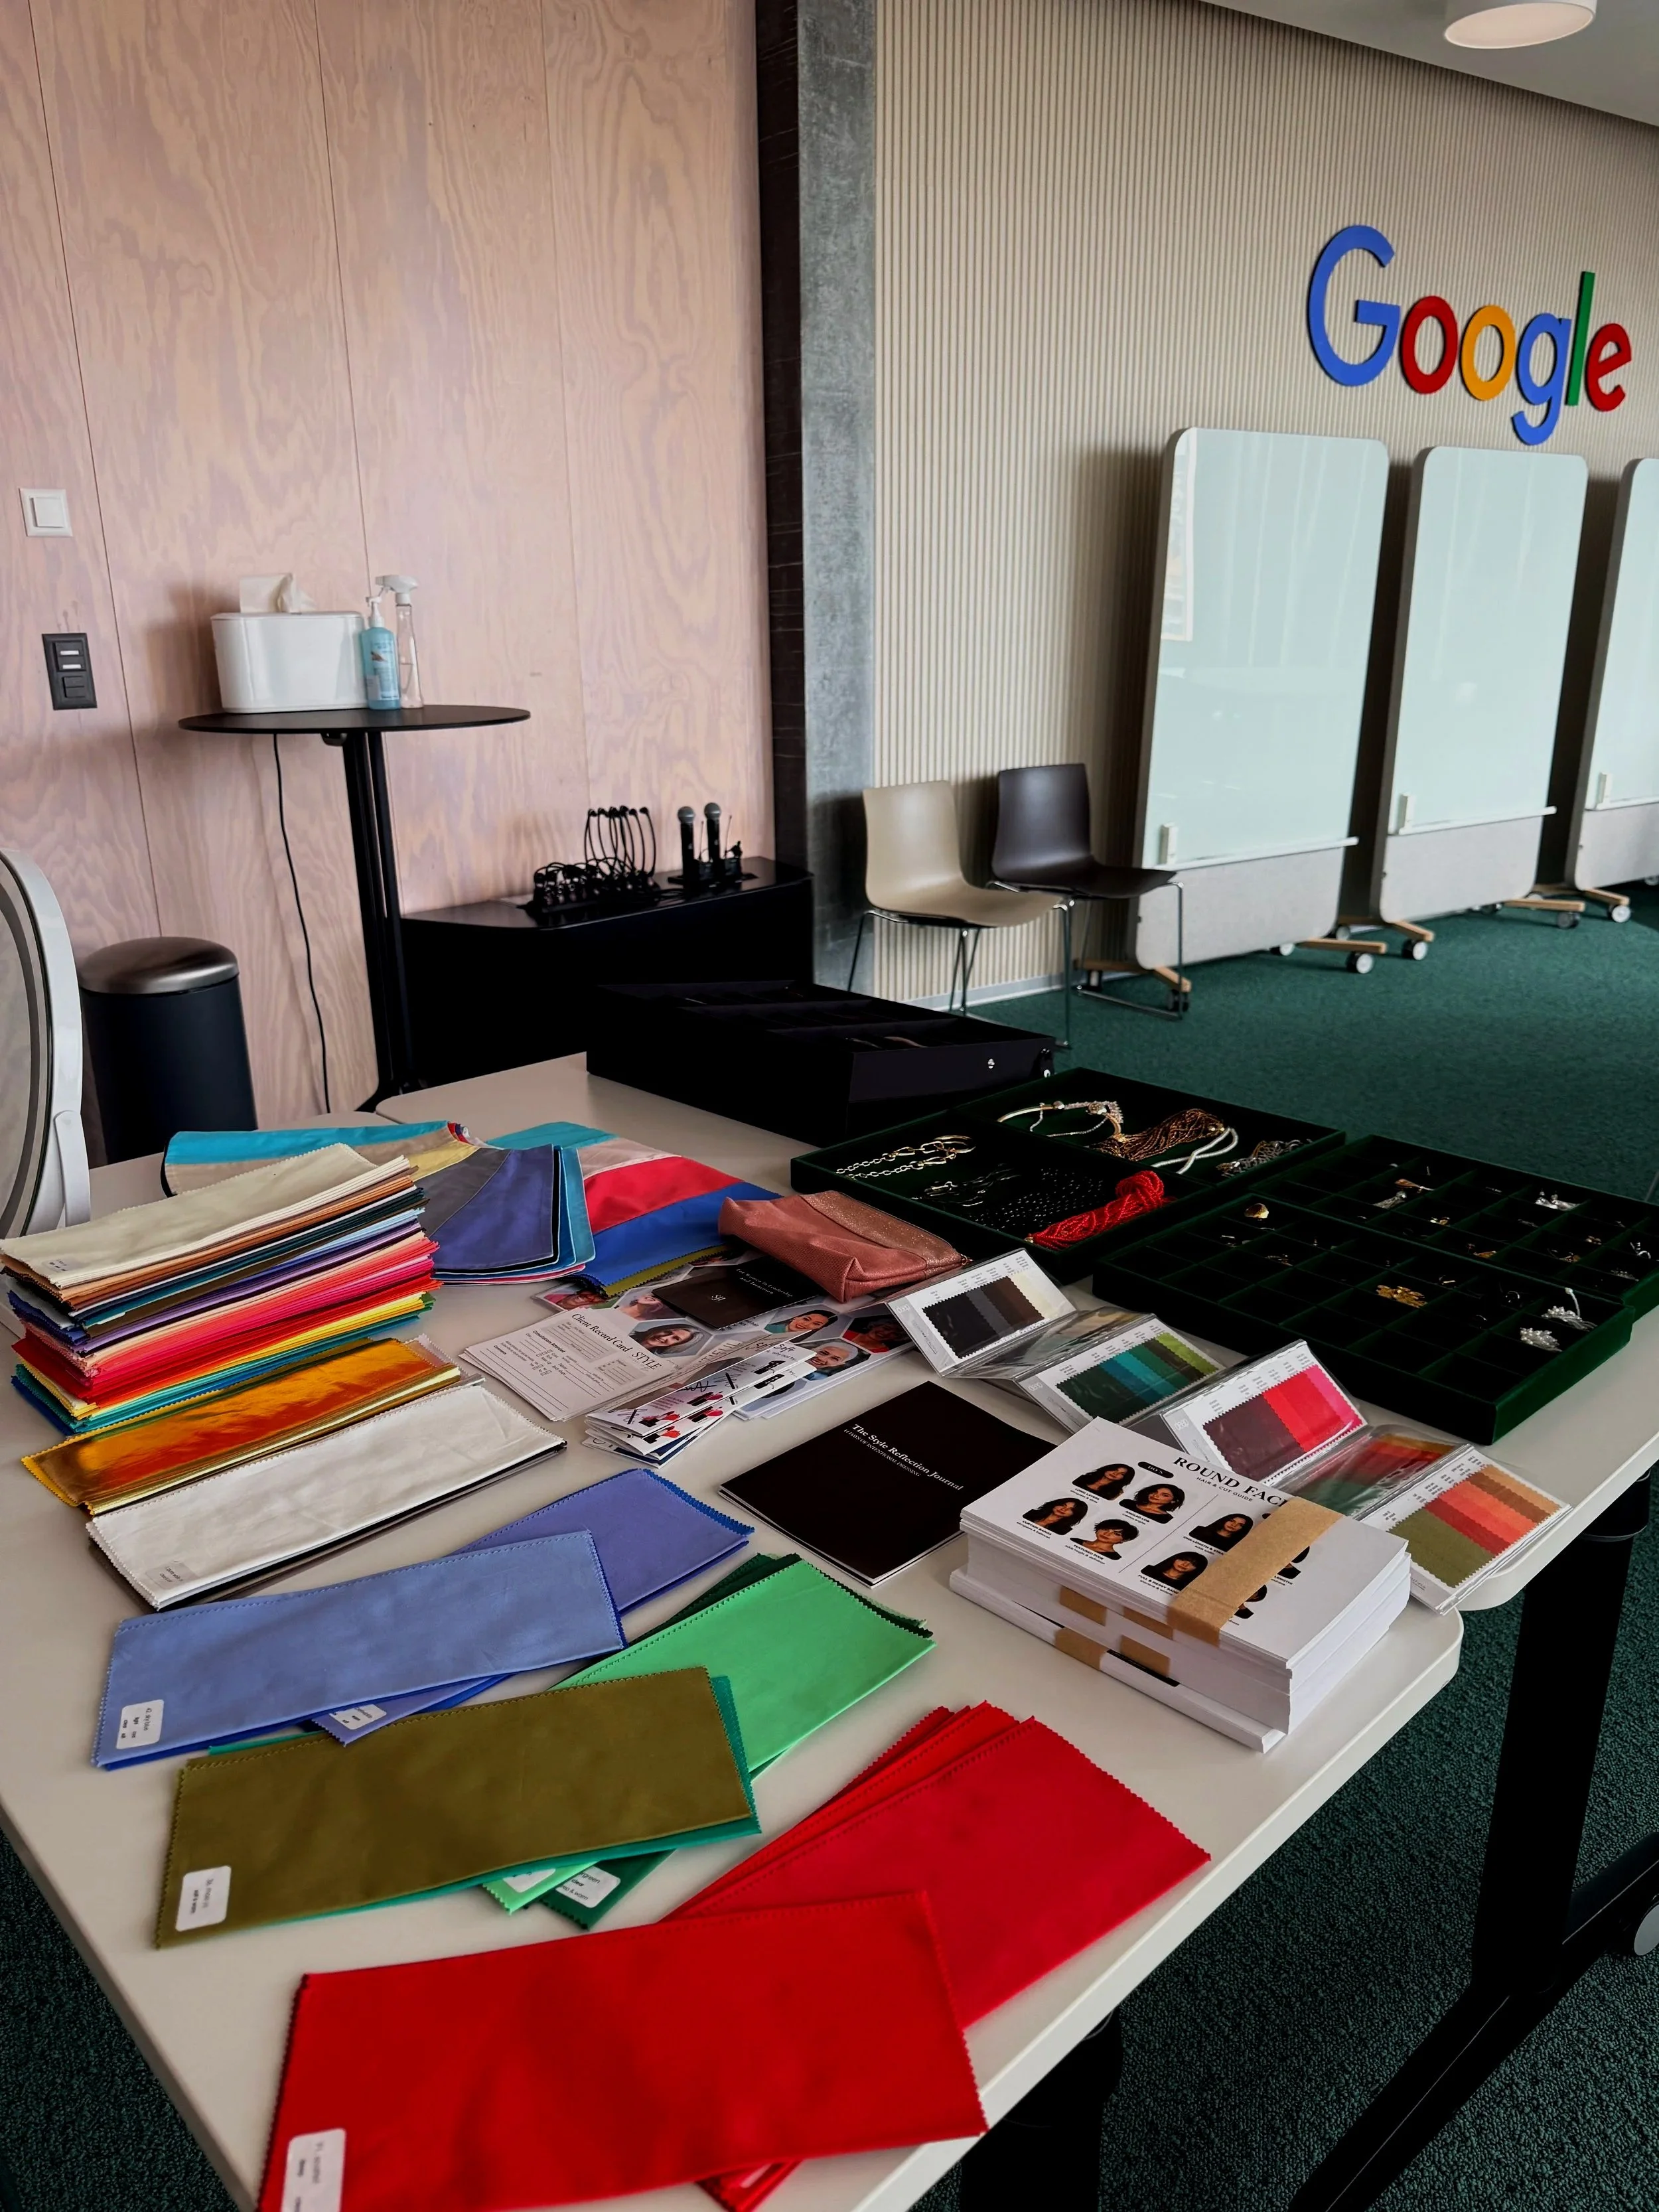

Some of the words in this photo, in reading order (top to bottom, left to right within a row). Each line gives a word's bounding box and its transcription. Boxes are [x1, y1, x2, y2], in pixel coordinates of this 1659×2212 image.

[1307, 224, 1632, 445] Google
[572, 1313, 591, 1328] Client
[590, 1325, 616, 1342] Record
[613, 1339, 633, 1352] Card
[632, 1351, 662, 1370] STYLE
[852, 1424, 869, 1436] The
[868, 1434, 889, 1449] Style
[888, 1447, 930, 1474] Reflection
[927, 1471, 964, 1491] Journal
[1173, 1457, 1240, 1489] ROUND
[1195, 1476, 1212, 1485] HAIR
[1232, 1491, 1254, 1502] GUIDE
[571, 1878, 585, 1887] clear
[580, 1872, 601, 1884] rgreen
